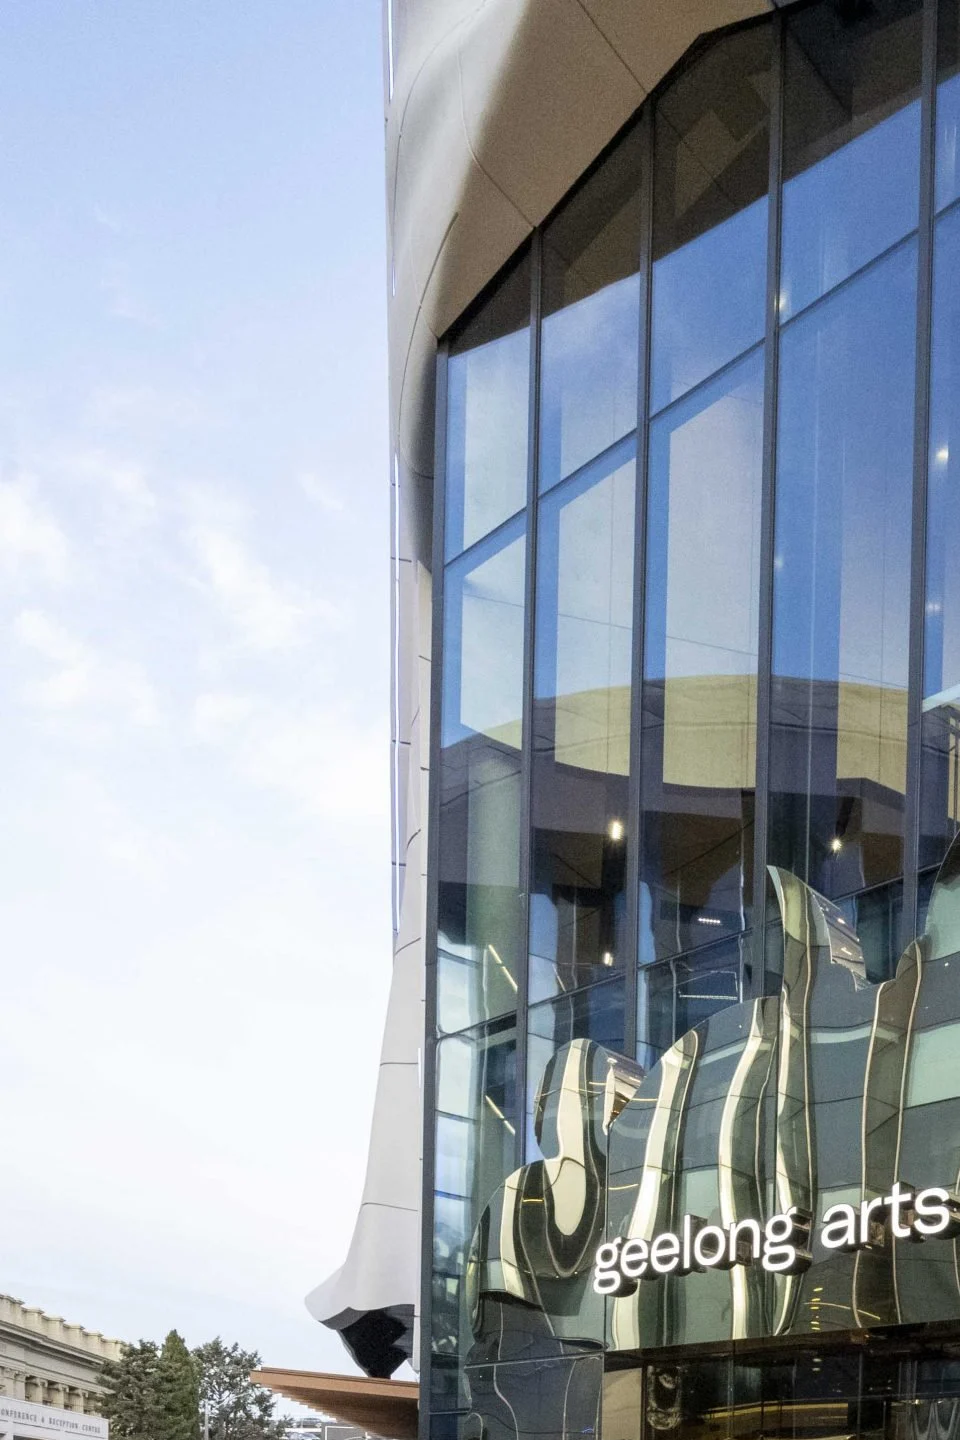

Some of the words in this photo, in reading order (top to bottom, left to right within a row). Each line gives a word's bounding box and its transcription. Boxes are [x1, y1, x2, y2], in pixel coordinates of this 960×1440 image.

[593, 1206, 798, 1295] geelong
[821, 1181, 949, 1249] arts
[49, 1417, 78, 1429] RECEPTION
